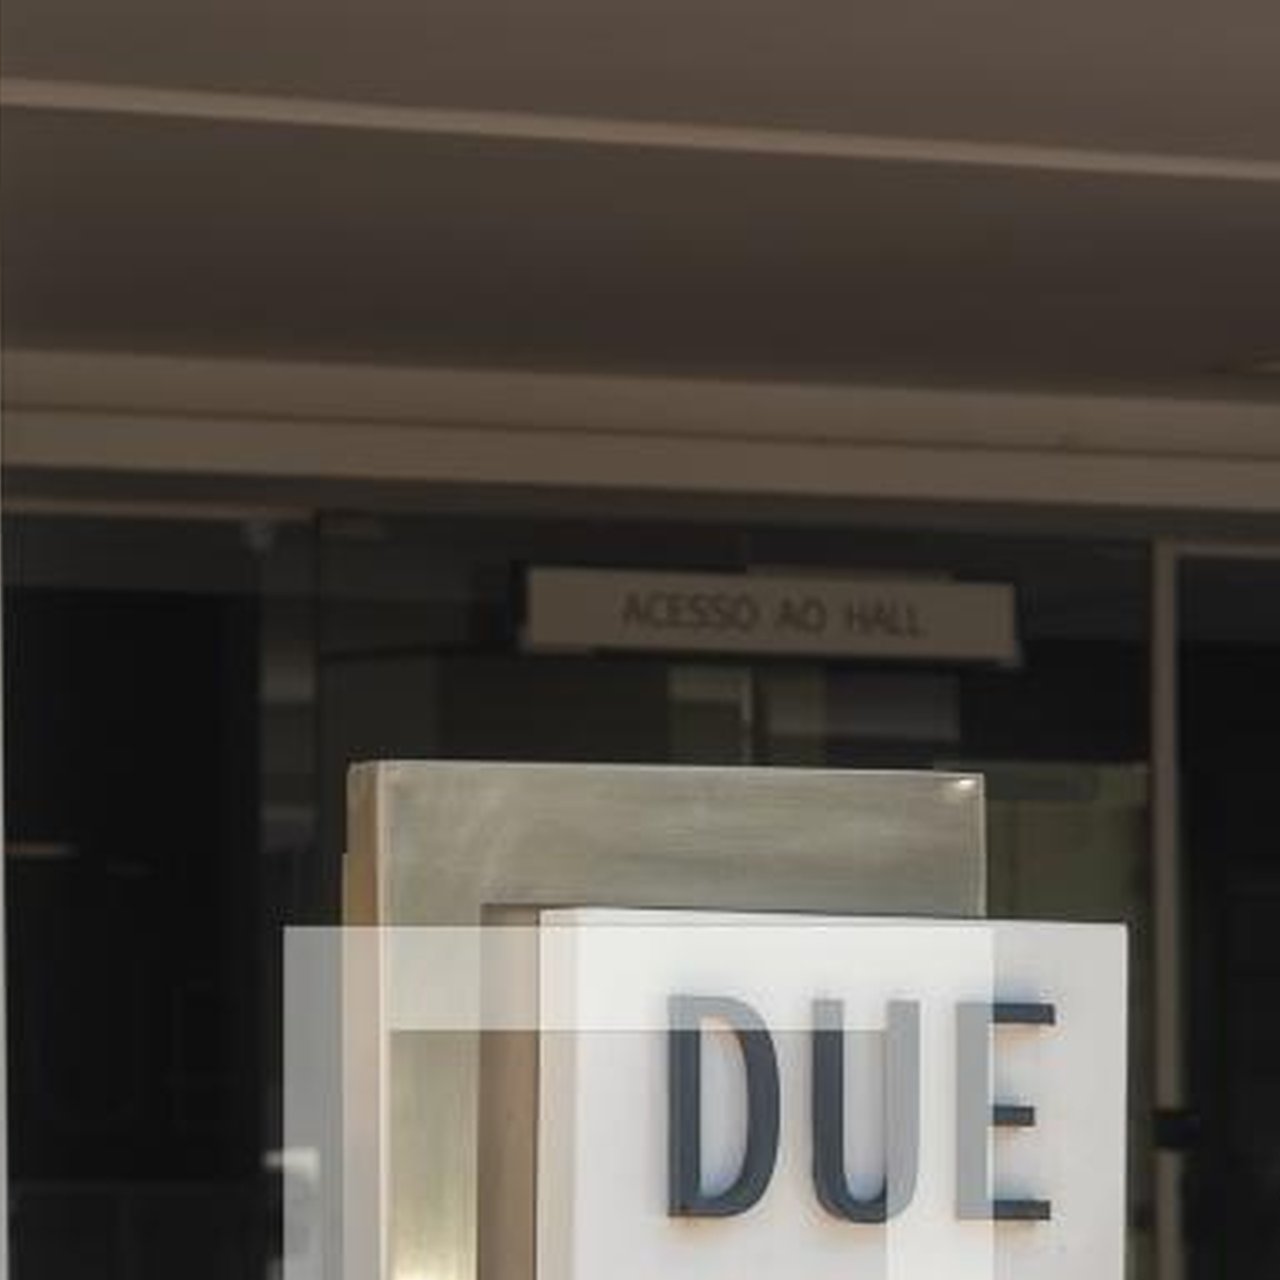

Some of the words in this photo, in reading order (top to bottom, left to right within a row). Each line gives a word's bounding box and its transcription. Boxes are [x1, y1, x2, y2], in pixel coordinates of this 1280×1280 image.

[621, 591, 758, 632] ACESSO
[775, 598, 829, 634] AO
[847, 602, 925, 638] HALL
[667, 997, 1057, 1223] DUE
